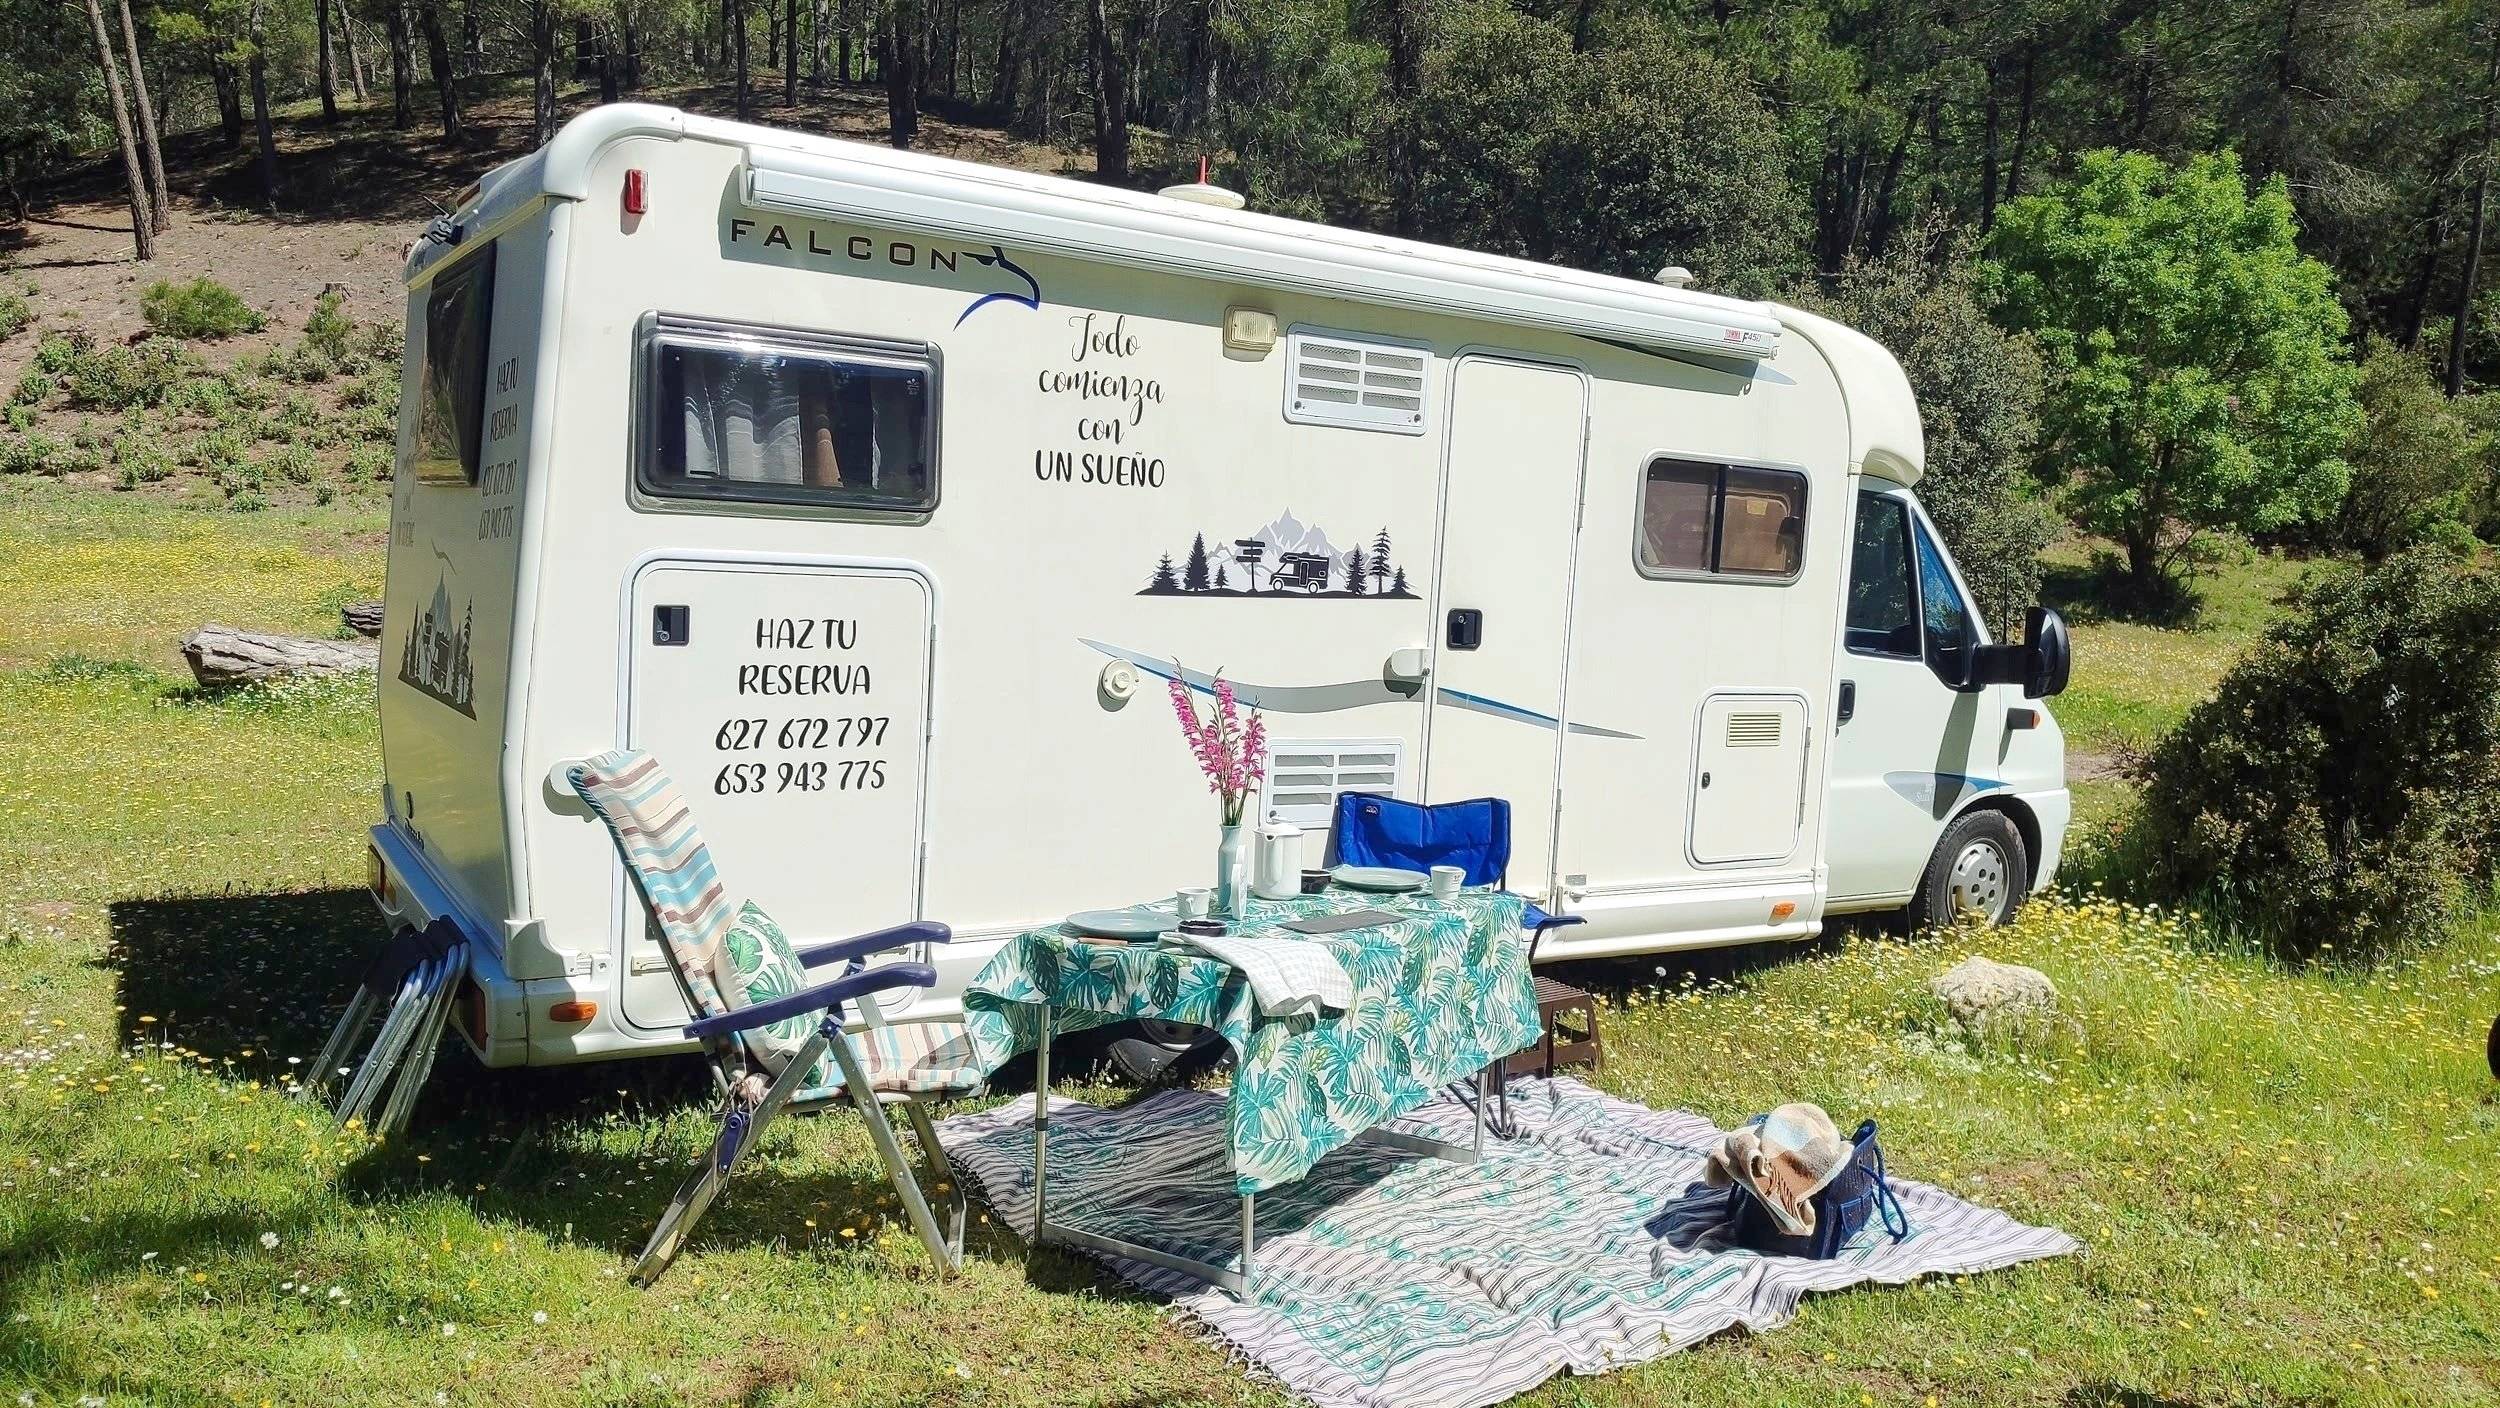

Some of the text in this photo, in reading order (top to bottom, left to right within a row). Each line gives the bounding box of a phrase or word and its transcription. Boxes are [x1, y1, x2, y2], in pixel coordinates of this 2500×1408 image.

[731, 219, 956, 272] FALCON
[1069, 313, 1141, 362] Todo
[1039, 370, 1165, 426] comienza
[1078, 418, 1125, 445] con
[1036, 450, 1165, 488] UN SUEÑO
[756, 618, 857, 649] HAZ TU
[739, 664, 871, 695] RESERVA
[715, 717, 890, 750] 627 672 797
[714, 760, 887, 795] 653 943 775
